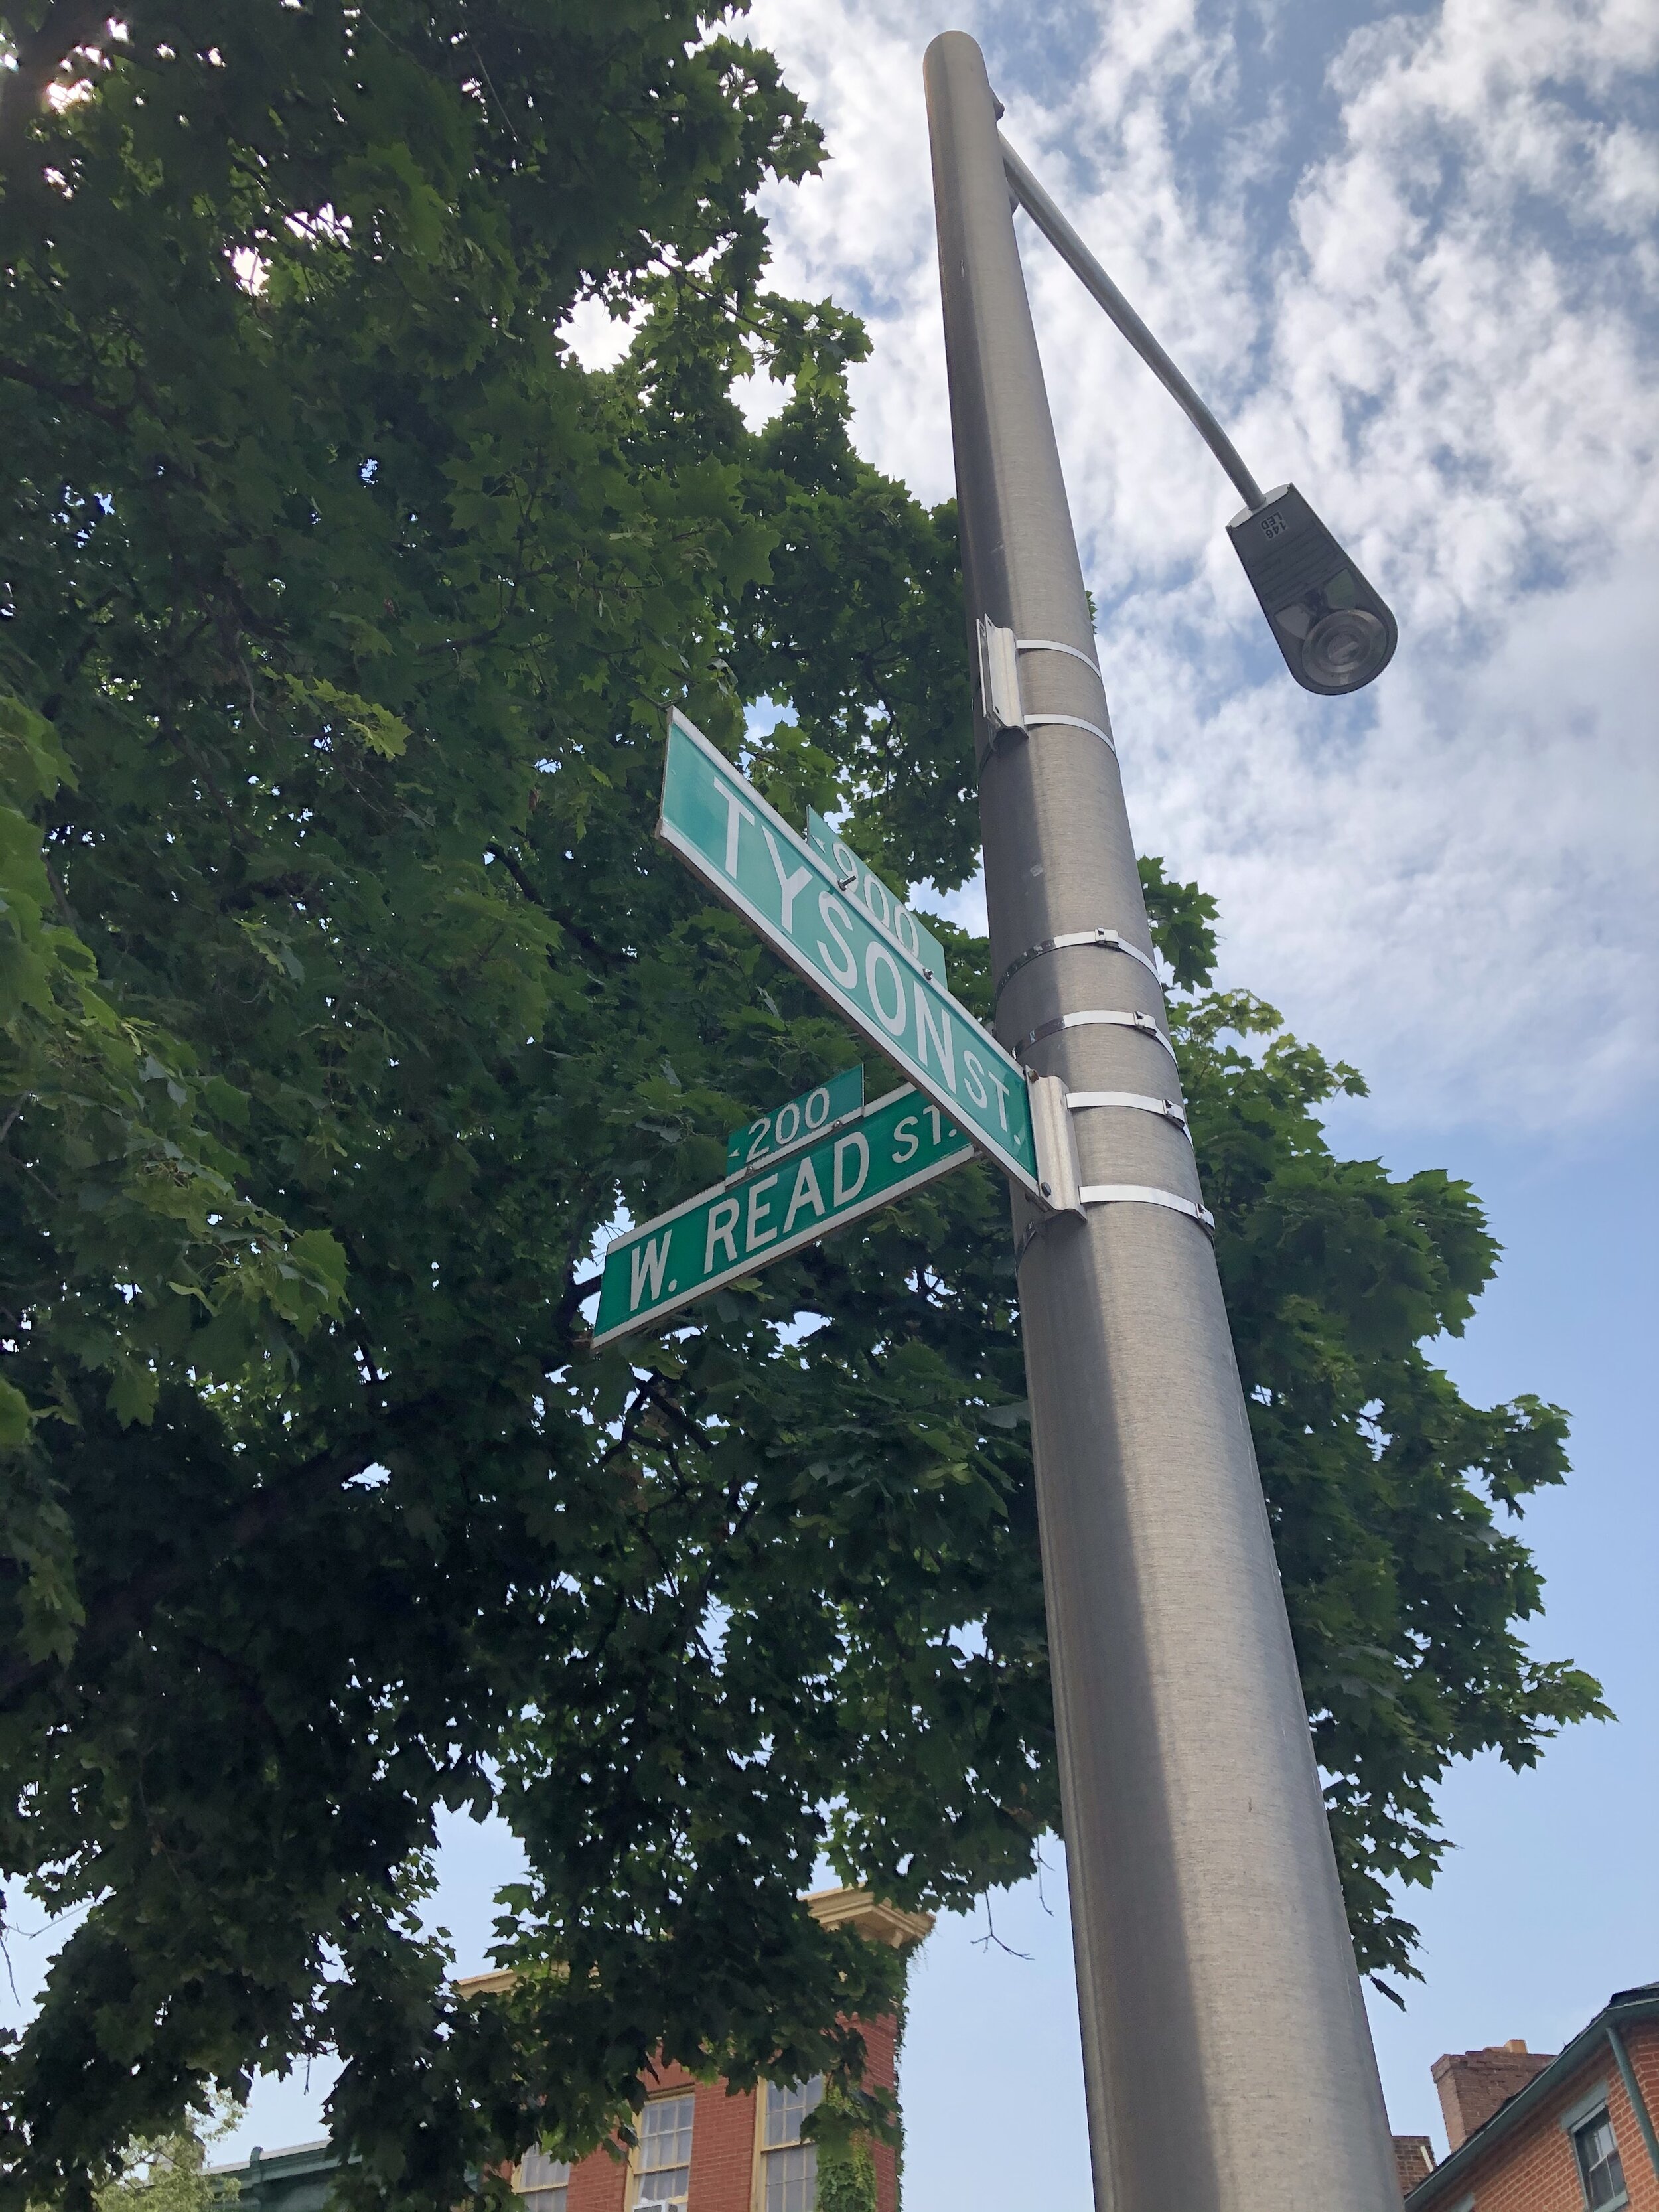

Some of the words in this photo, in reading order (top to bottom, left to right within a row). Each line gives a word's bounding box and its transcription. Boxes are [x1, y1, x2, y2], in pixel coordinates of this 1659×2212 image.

[1261, 512, 1283, 530] LED
[1265, 521, 1286, 539] 146
[832, 842, 920, 960] 900
[713, 776, 957, 1094] TYSON
[964, 1050, 1022, 1145] ST.
[746, 1087, 830, 1163] 200
[629, 1228, 678, 1312] W.
[703, 1130, 870, 1275] READ
[891, 1104, 957, 1163] ST.
